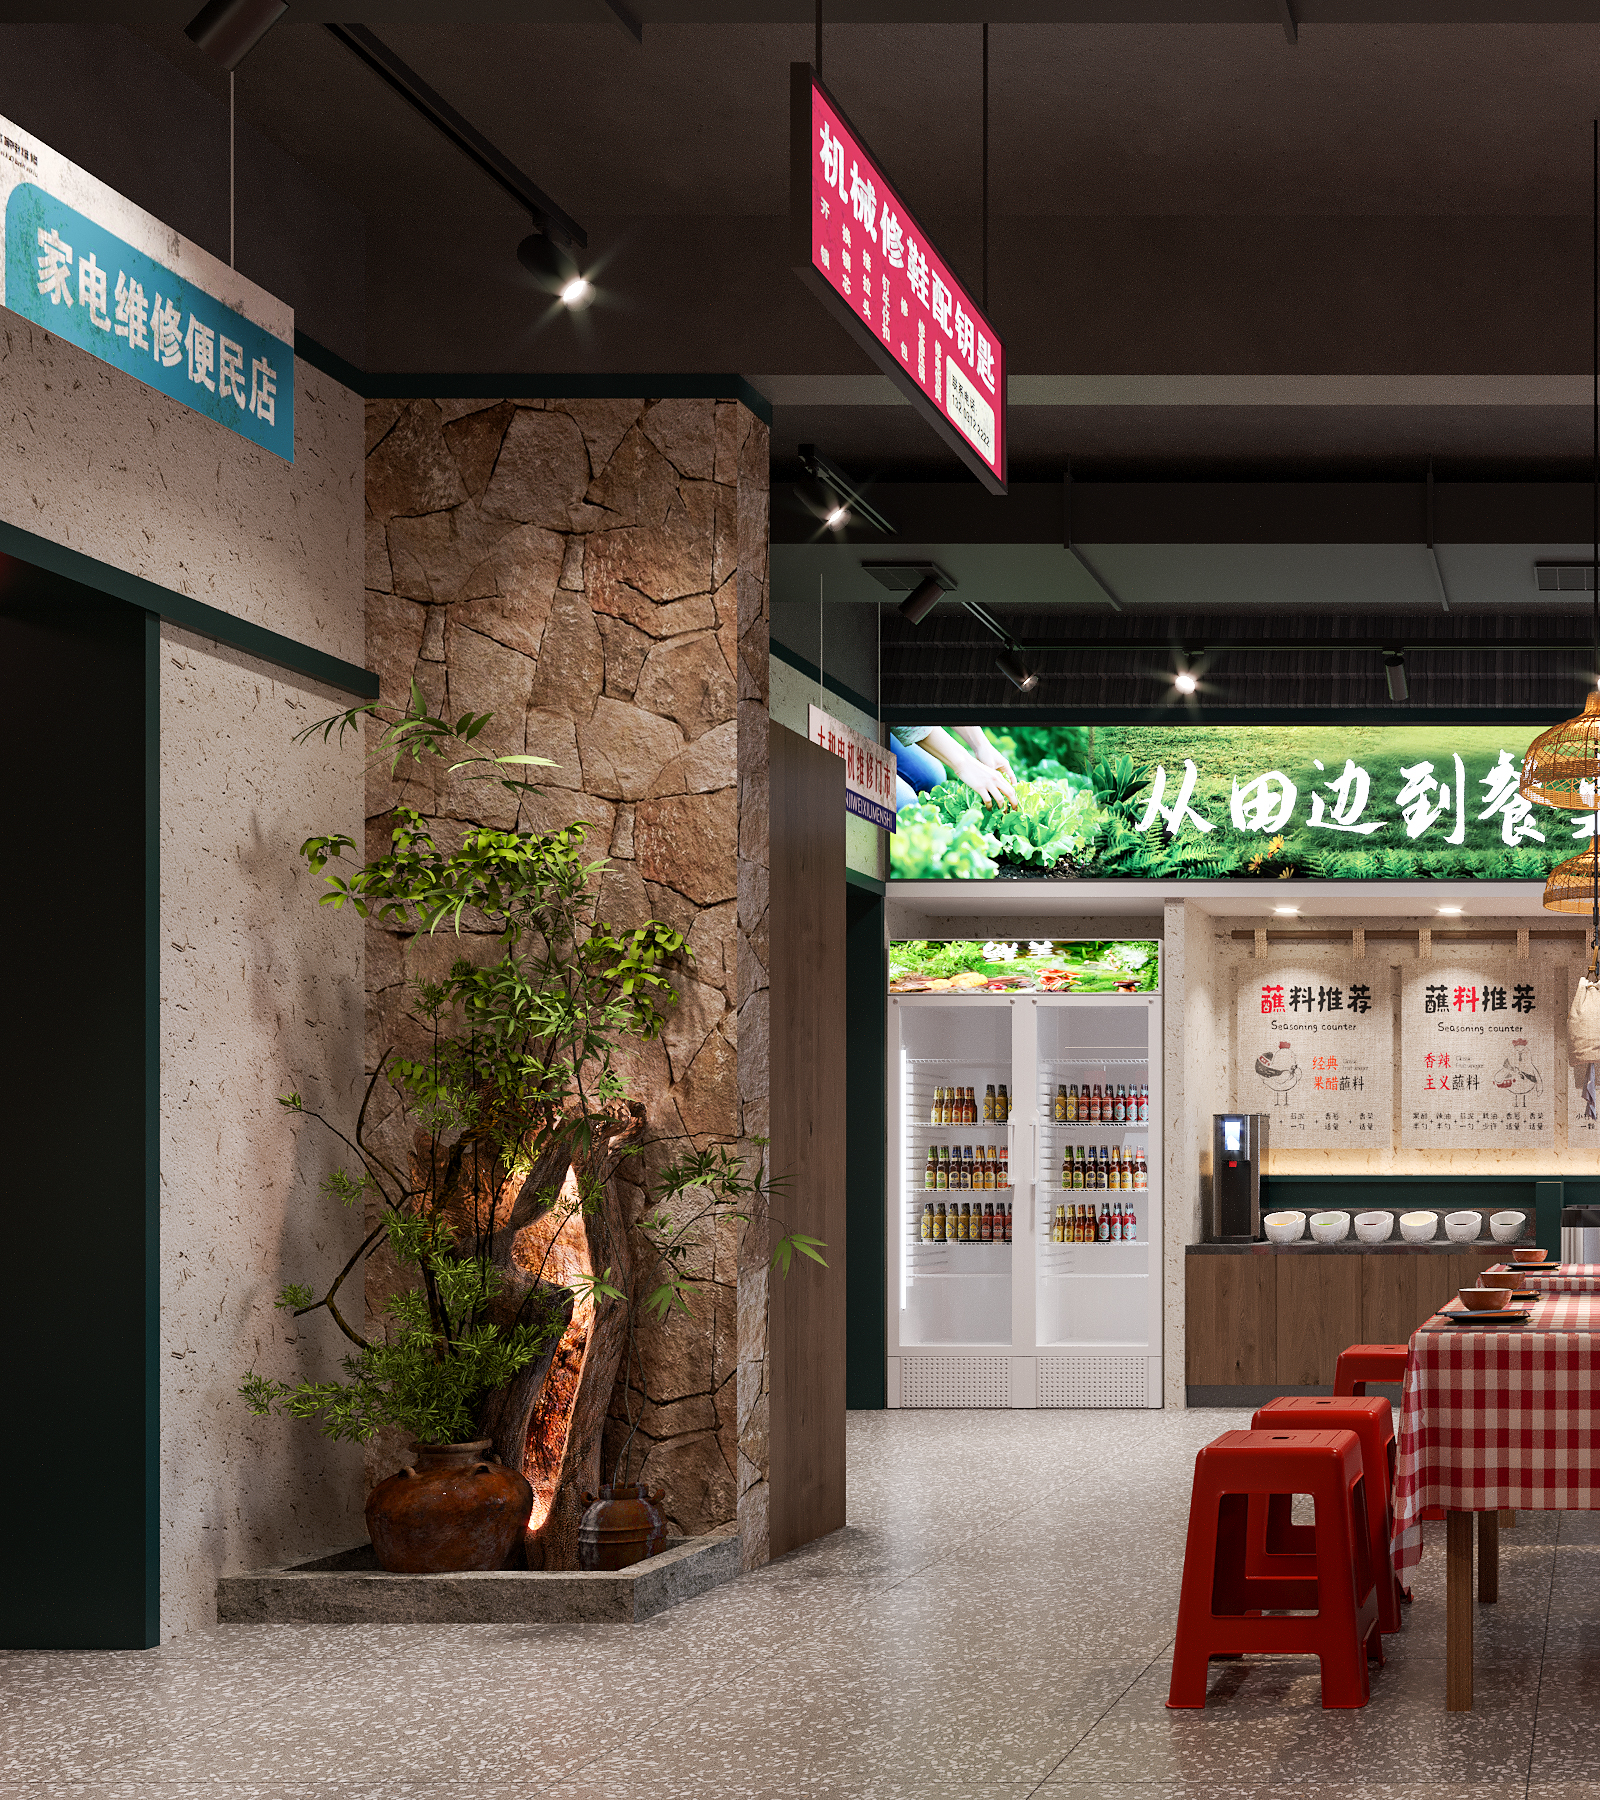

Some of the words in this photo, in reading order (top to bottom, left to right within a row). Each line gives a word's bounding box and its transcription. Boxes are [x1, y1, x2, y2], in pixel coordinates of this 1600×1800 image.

[820, 196, 830, 270] 开锁
[819, 120, 996, 395] 机械修鞋配钥匙
[36, 228, 278, 427] 家电维修便民店
[1261, 984, 1372, 1014] 蘸料推荐
[1425, 984, 1536, 1014] 蘸料推荐
[1271, 1020, 1318, 1033] Seasoning
[1321, 1023, 1357, 1031] counter
[1438, 1022, 1484, 1034] Seasoning
[1312, 1055, 1339, 1071] 经典
[1423, 1052, 1451, 1069] 香辣
[1312, 1076, 1364, 1091] 果醋蘸料
[1424, 1074, 1480, 1091] 主义蘸料
